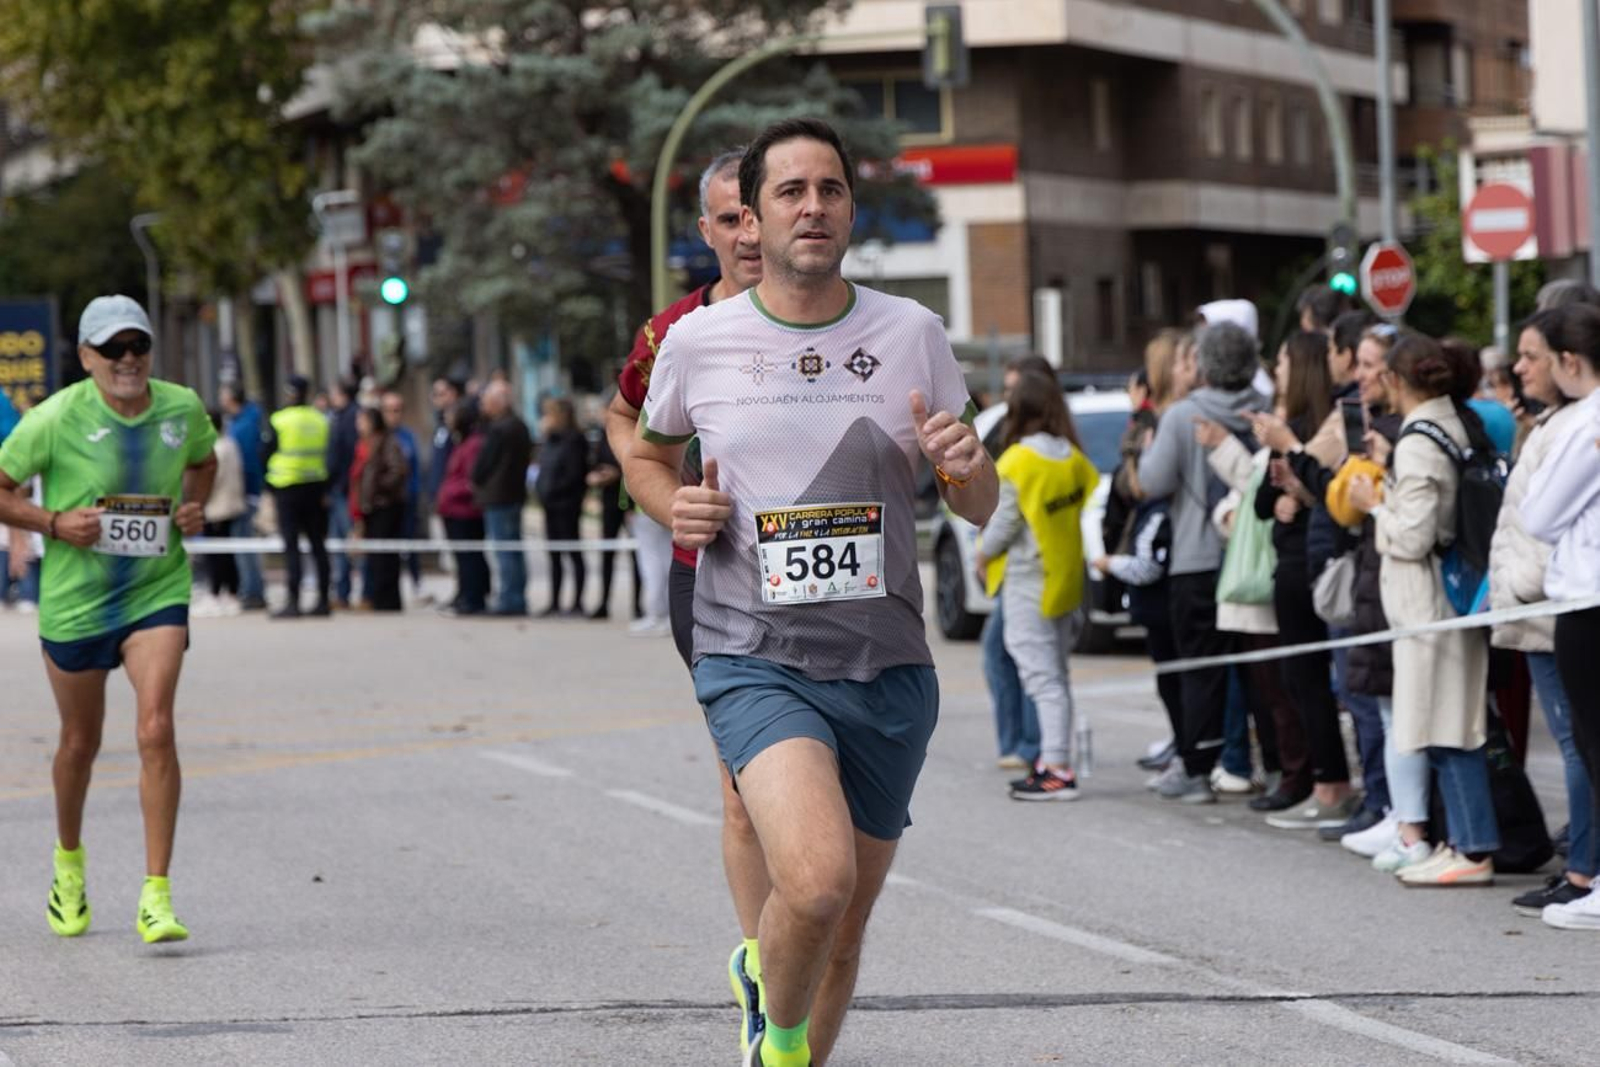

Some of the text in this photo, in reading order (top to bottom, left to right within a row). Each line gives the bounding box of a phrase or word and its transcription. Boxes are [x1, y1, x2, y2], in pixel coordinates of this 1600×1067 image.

[1372, 268, 1409, 290] STOP
[800, 394, 885, 404] ALOJAMIENTOS
[788, 510, 833, 520] CARRERA
[801, 519, 827, 529] gran
[833, 516, 867, 525] camina
[109, 518, 157, 542] 560
[785, 541, 861, 582] 584
